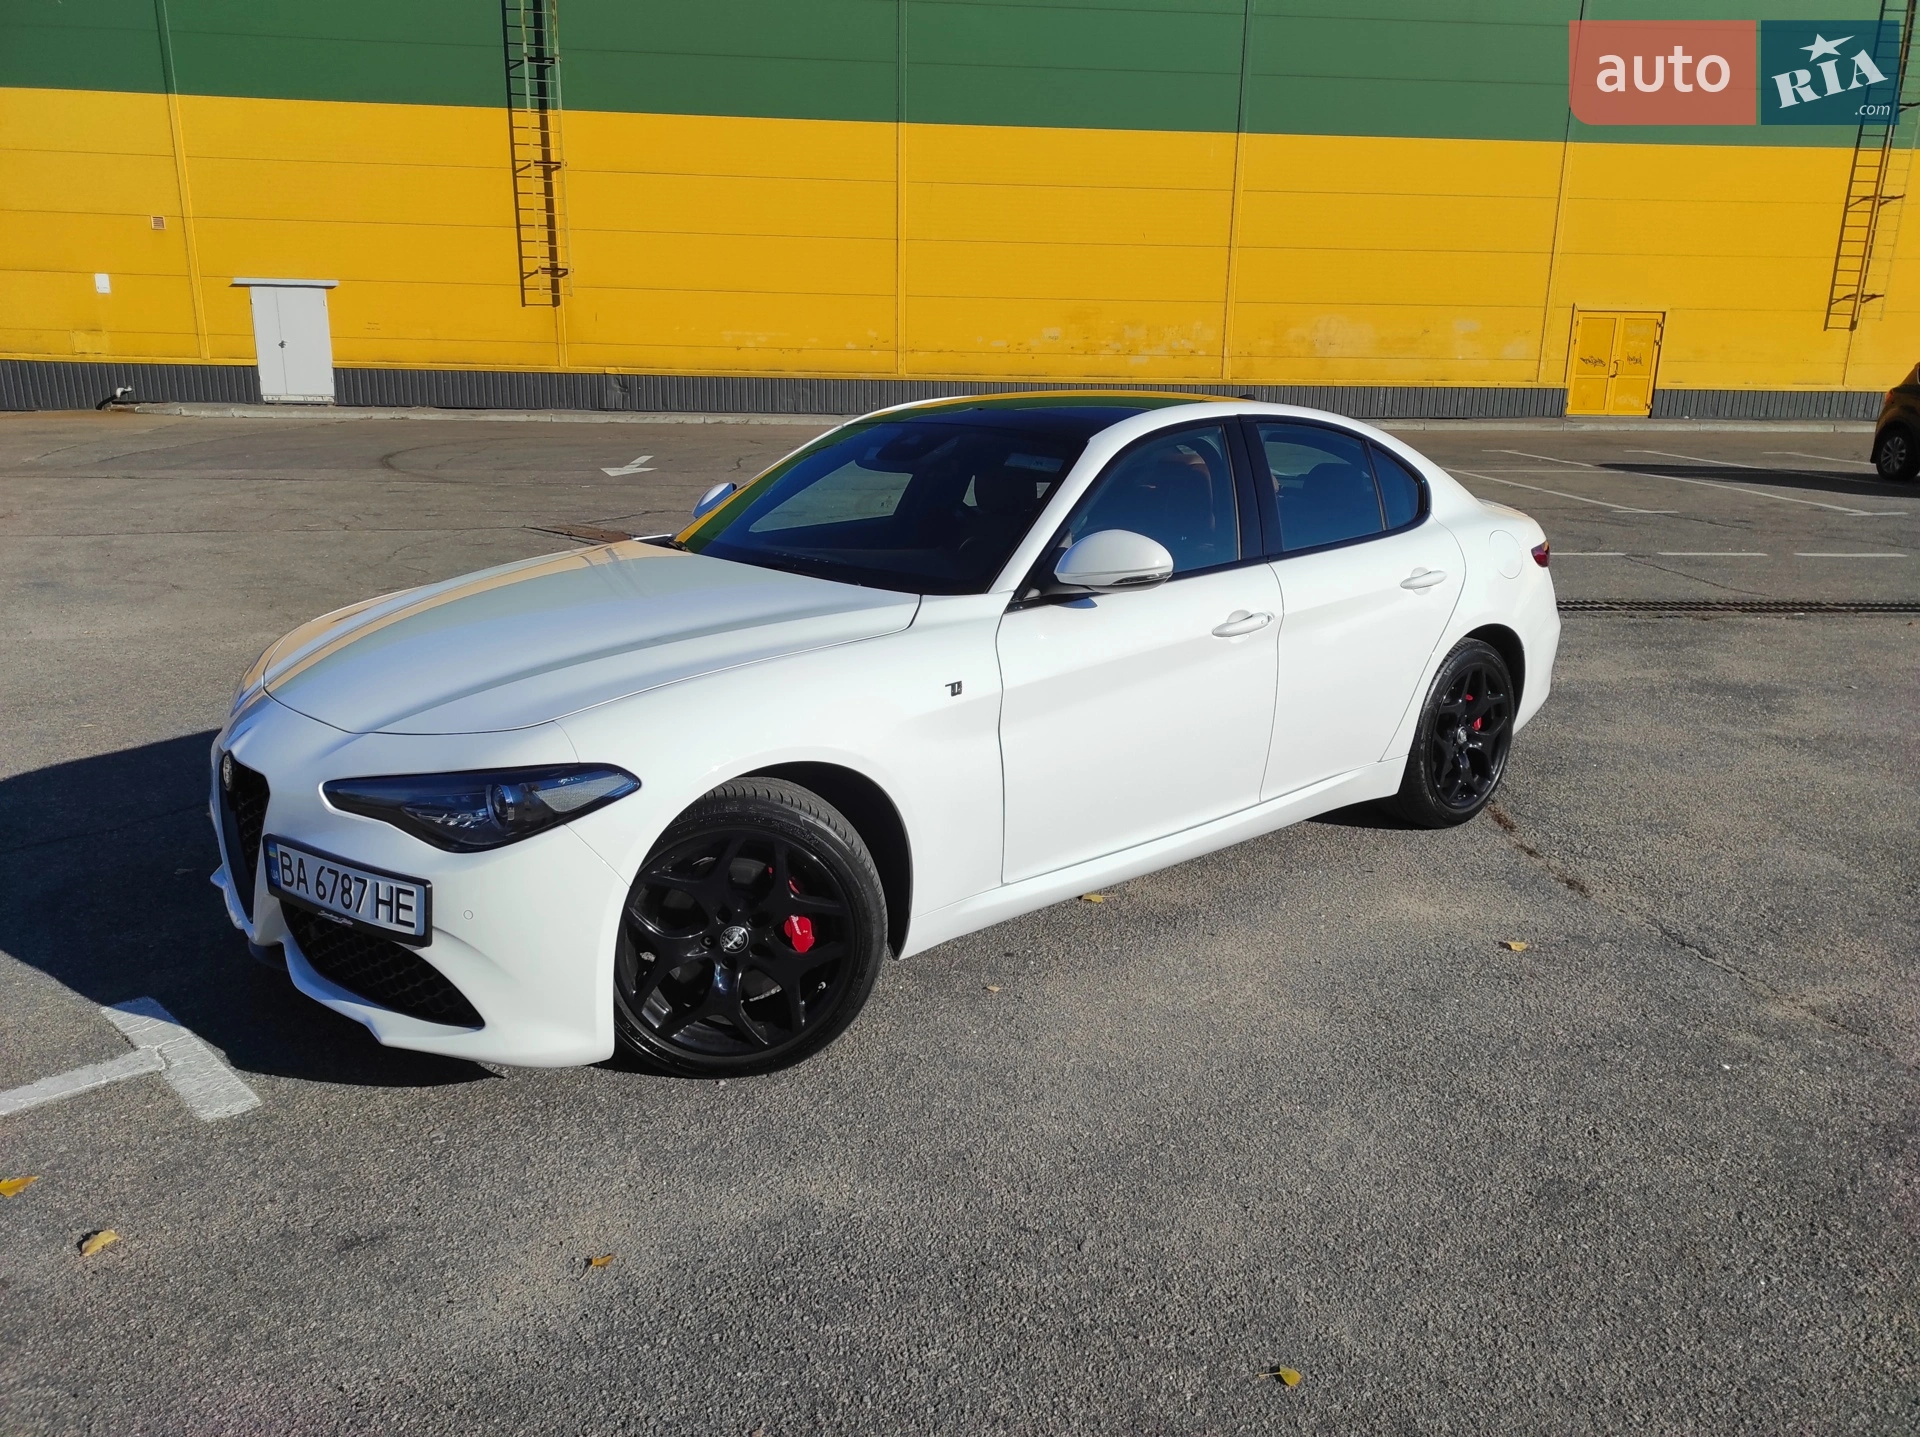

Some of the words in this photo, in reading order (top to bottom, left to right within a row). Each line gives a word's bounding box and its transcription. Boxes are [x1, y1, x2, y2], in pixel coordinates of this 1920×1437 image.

[279, 850, 309, 895] BA
[315, 865, 369, 914] 6787
[375, 881, 416, 929] HE
